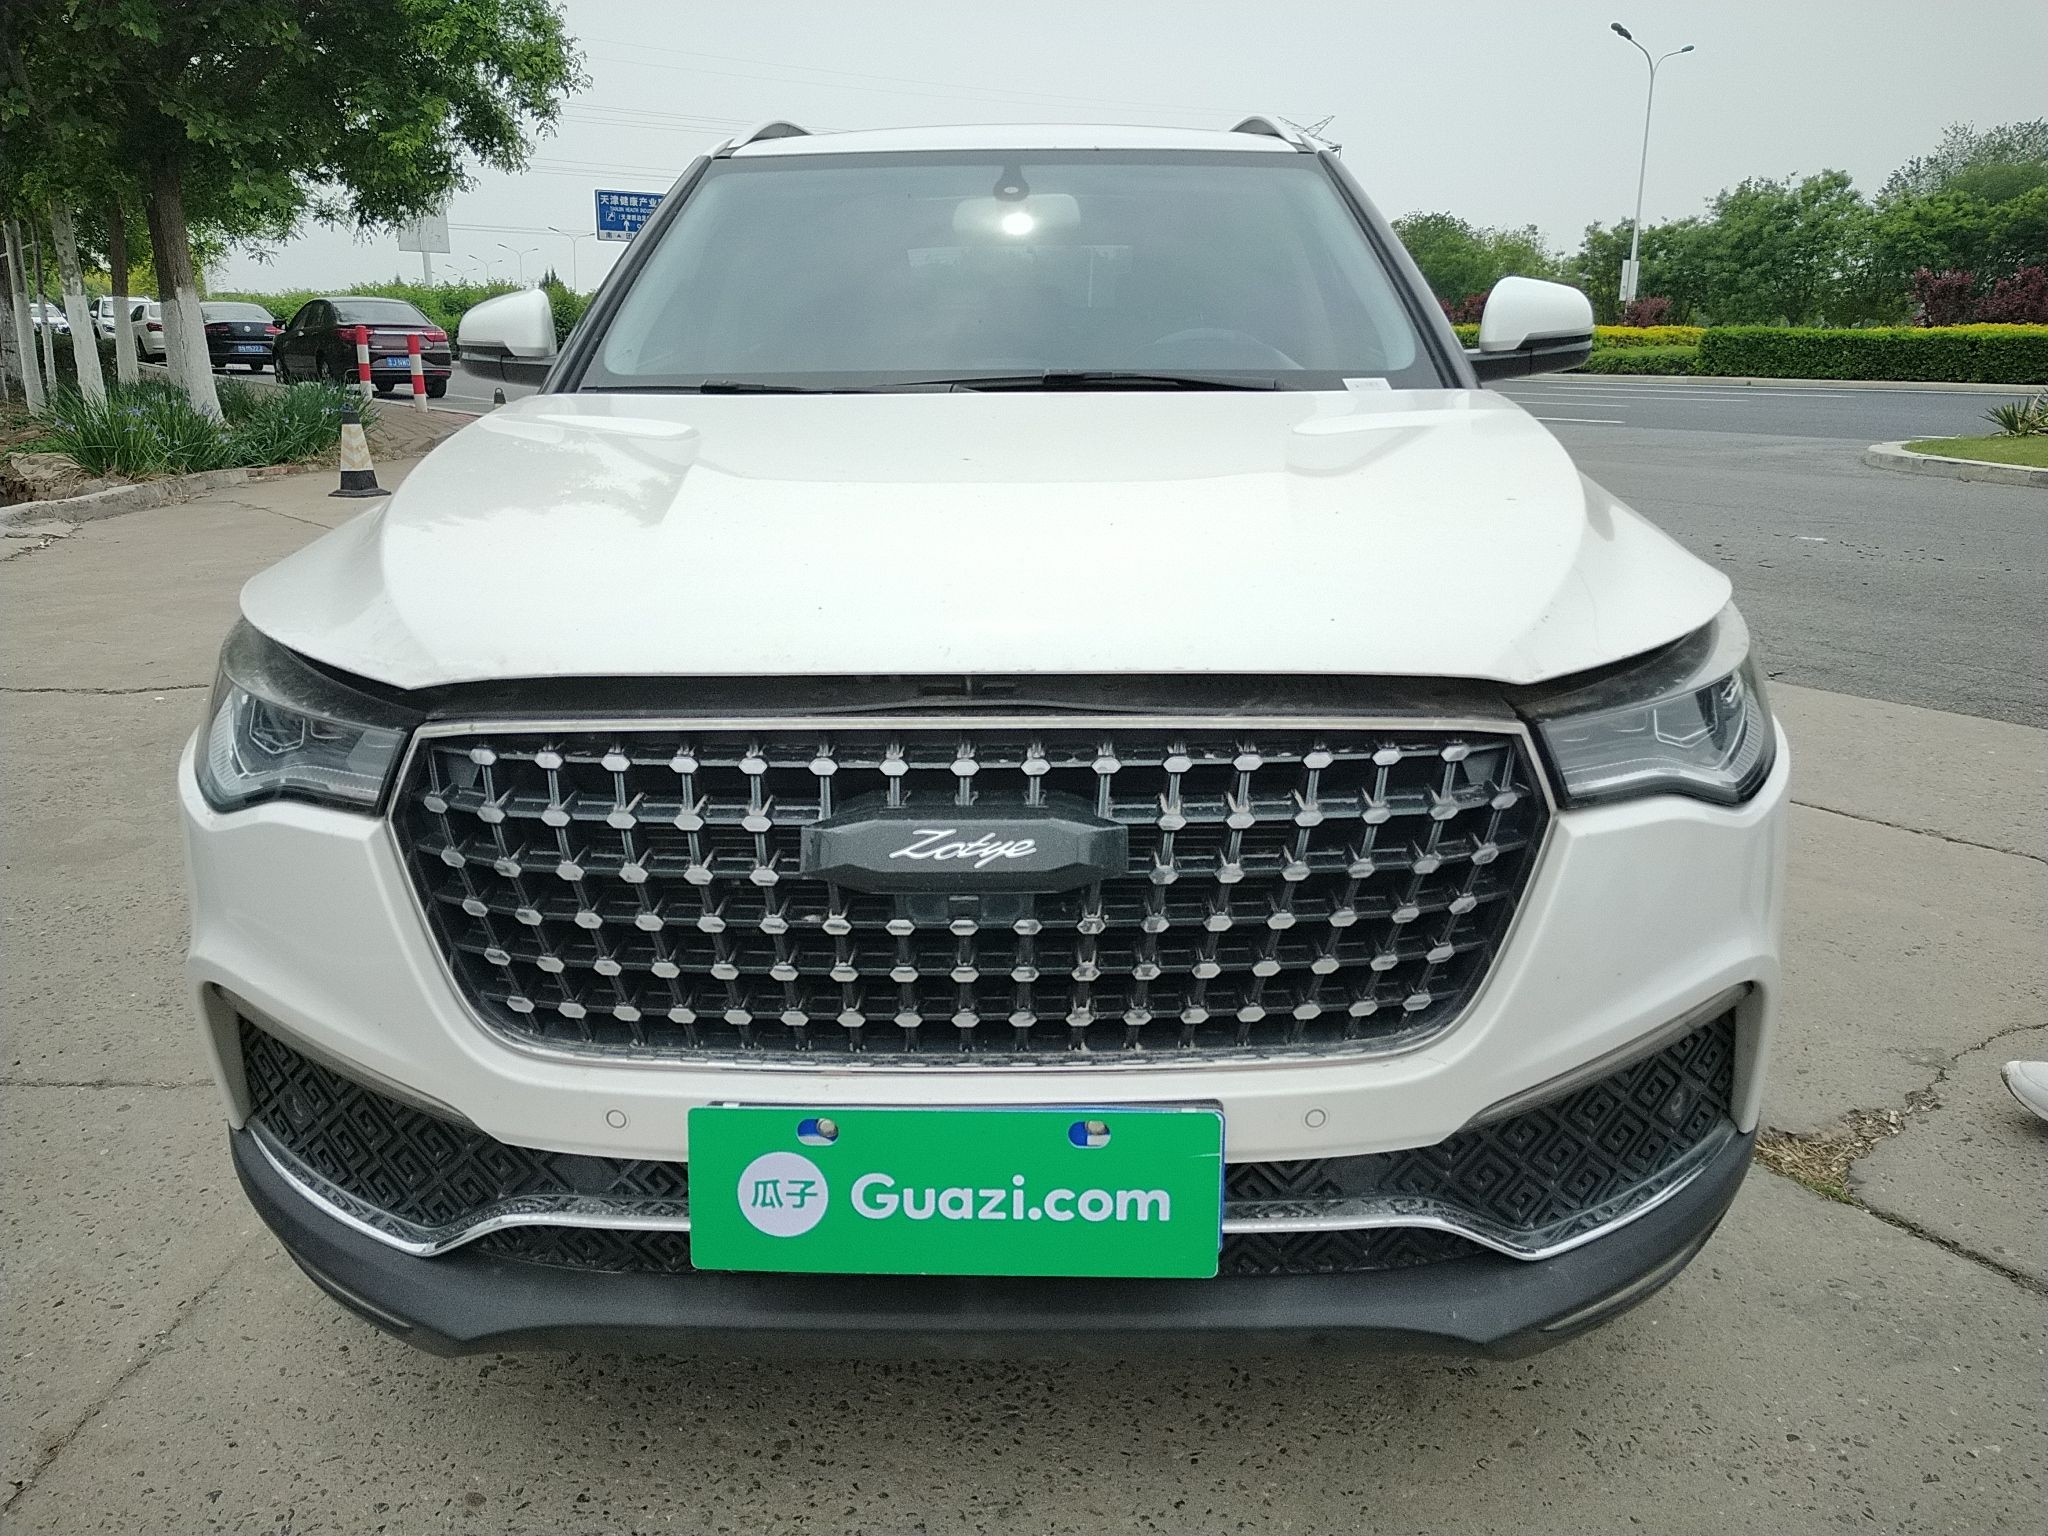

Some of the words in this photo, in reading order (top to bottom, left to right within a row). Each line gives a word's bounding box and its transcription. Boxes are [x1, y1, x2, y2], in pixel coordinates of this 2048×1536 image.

[600, 194, 662, 207] 天津健康产业
[889, 829, 1037, 869] Zotye
[751, 1178, 818, 1209] 瓜子
[850, 1173, 1171, 1222] Guazi.com
